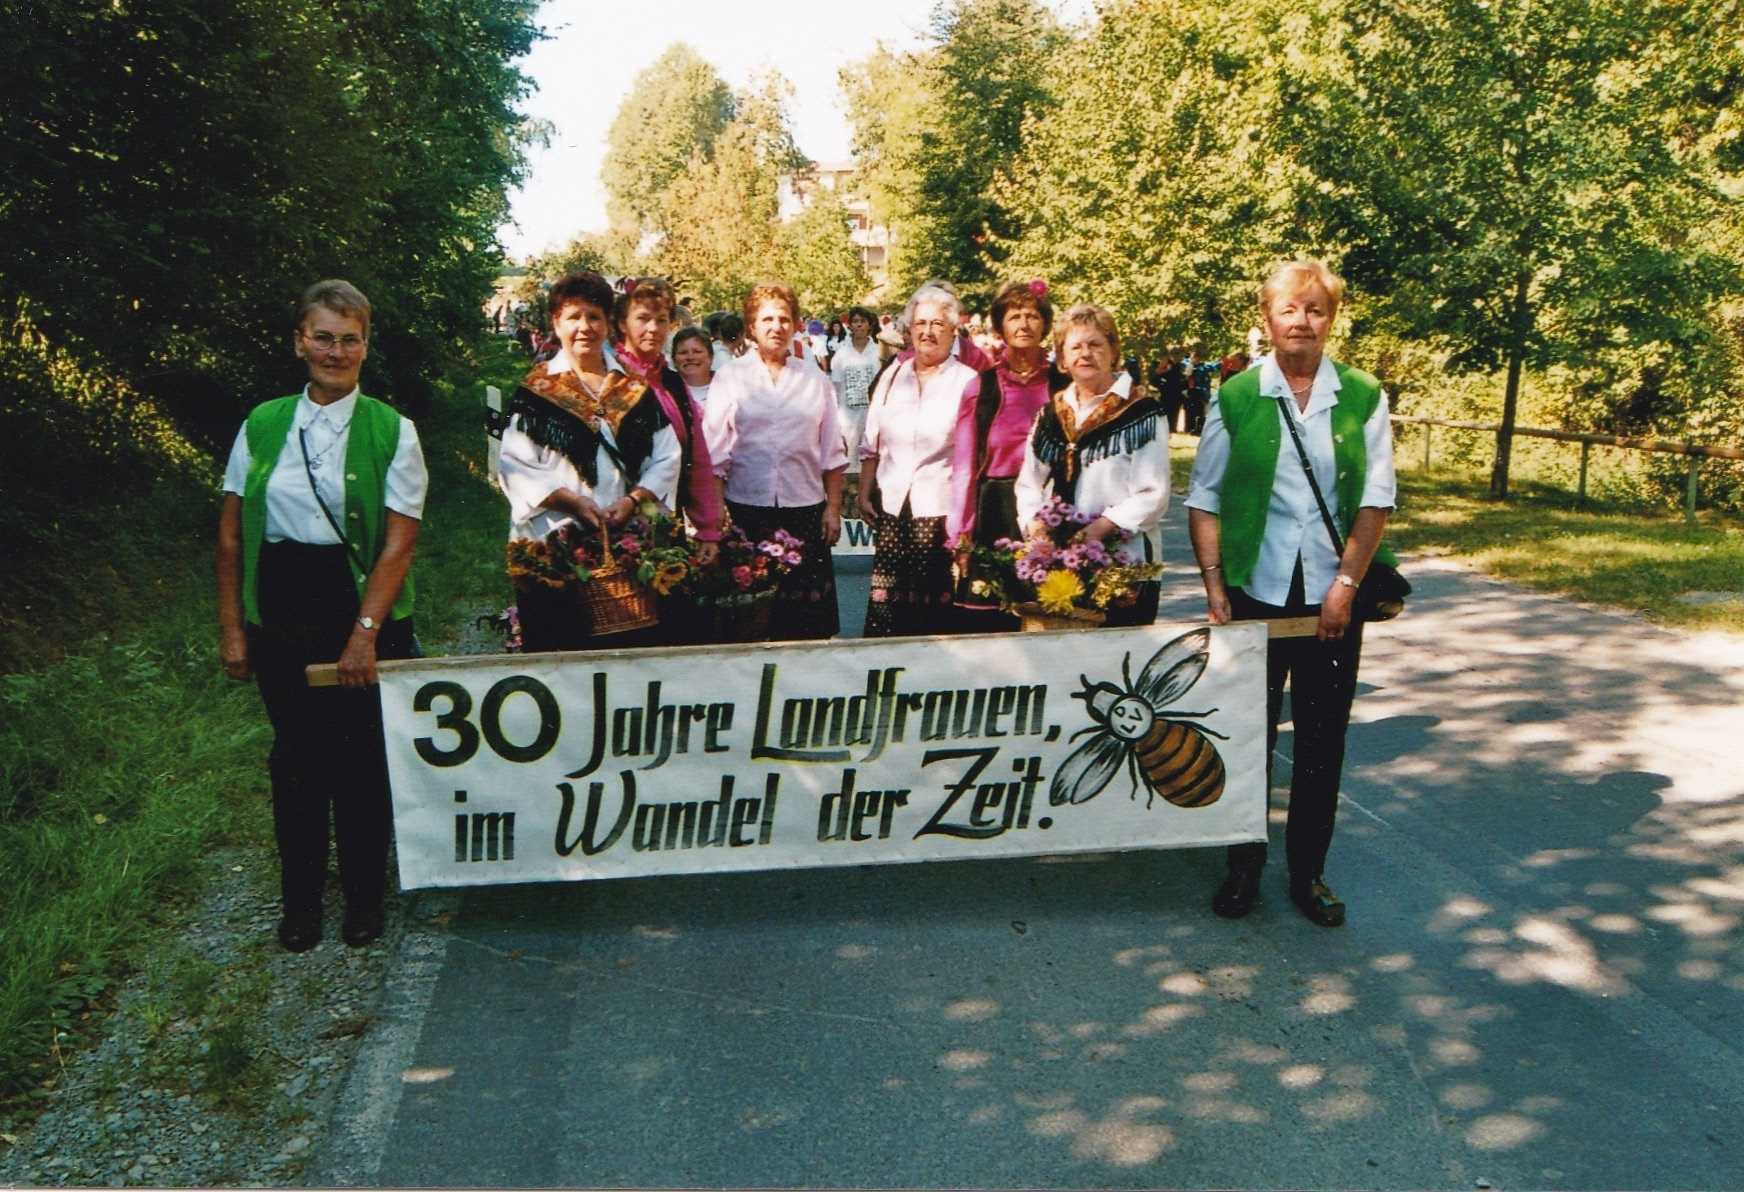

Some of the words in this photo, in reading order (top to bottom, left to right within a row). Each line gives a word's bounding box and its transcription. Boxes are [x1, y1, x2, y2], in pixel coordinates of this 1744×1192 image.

[412, 674, 561, 767] 30
[564, 672, 735, 779] Jahre
[750, 663, 1061, 763] Landfrauen,
[454, 790, 515, 863] im
[554, 769, 780, 856] Wandel
[816, 768, 911, 842] der
[913, 746, 1053, 840] Zeit.
